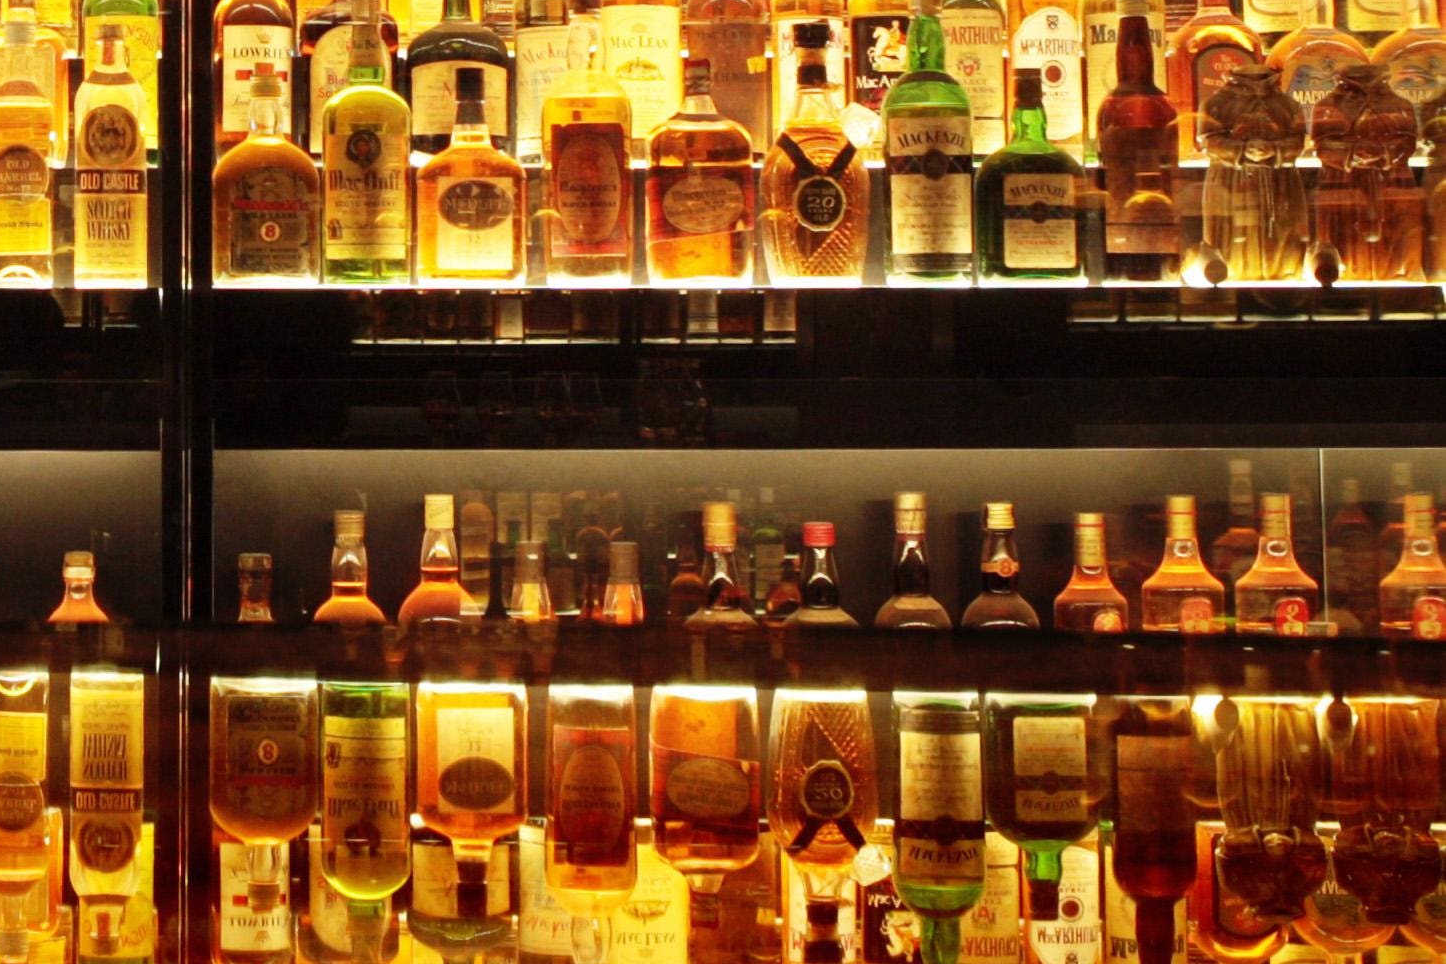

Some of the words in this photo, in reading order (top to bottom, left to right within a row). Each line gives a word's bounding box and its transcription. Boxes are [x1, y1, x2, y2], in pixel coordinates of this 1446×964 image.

[897, 129, 966, 150] MACKENZIE
[80, 173, 101, 191] OLD
[103, 172, 140, 191] CASTLE
[86, 199, 132, 222] SCOTCH
[806, 195, 836, 209] 20
[85, 220, 132, 242] WHISKY
[265, 223, 277, 236] 8
